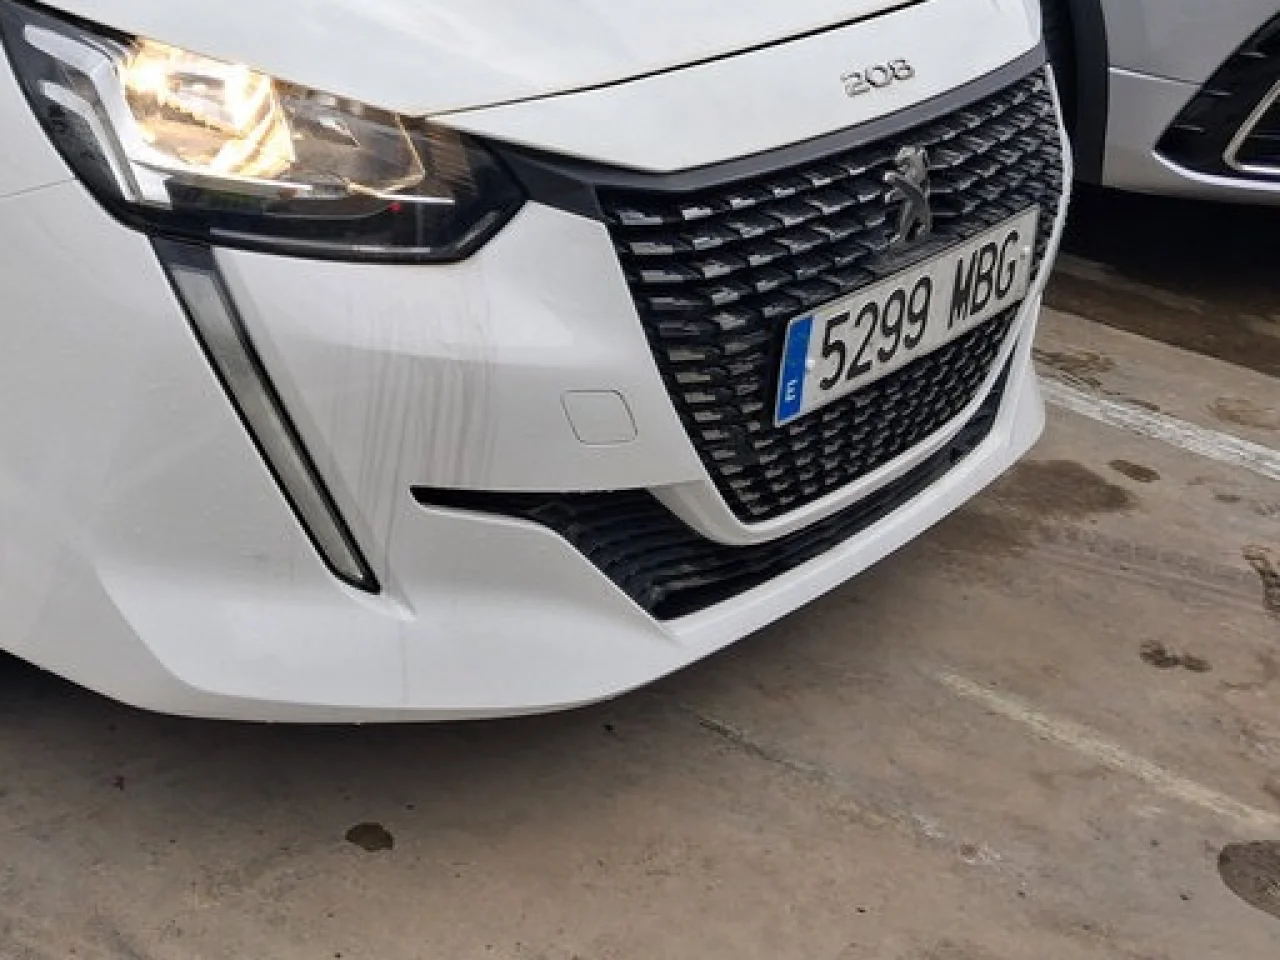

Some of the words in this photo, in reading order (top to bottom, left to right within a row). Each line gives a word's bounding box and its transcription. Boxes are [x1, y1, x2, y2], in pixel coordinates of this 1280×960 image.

[840, 58, 916, 97] 208
[819, 274, 933, 390] 5299
[948, 230, 1020, 330] MBG
[784, 379, 798, 403] E
